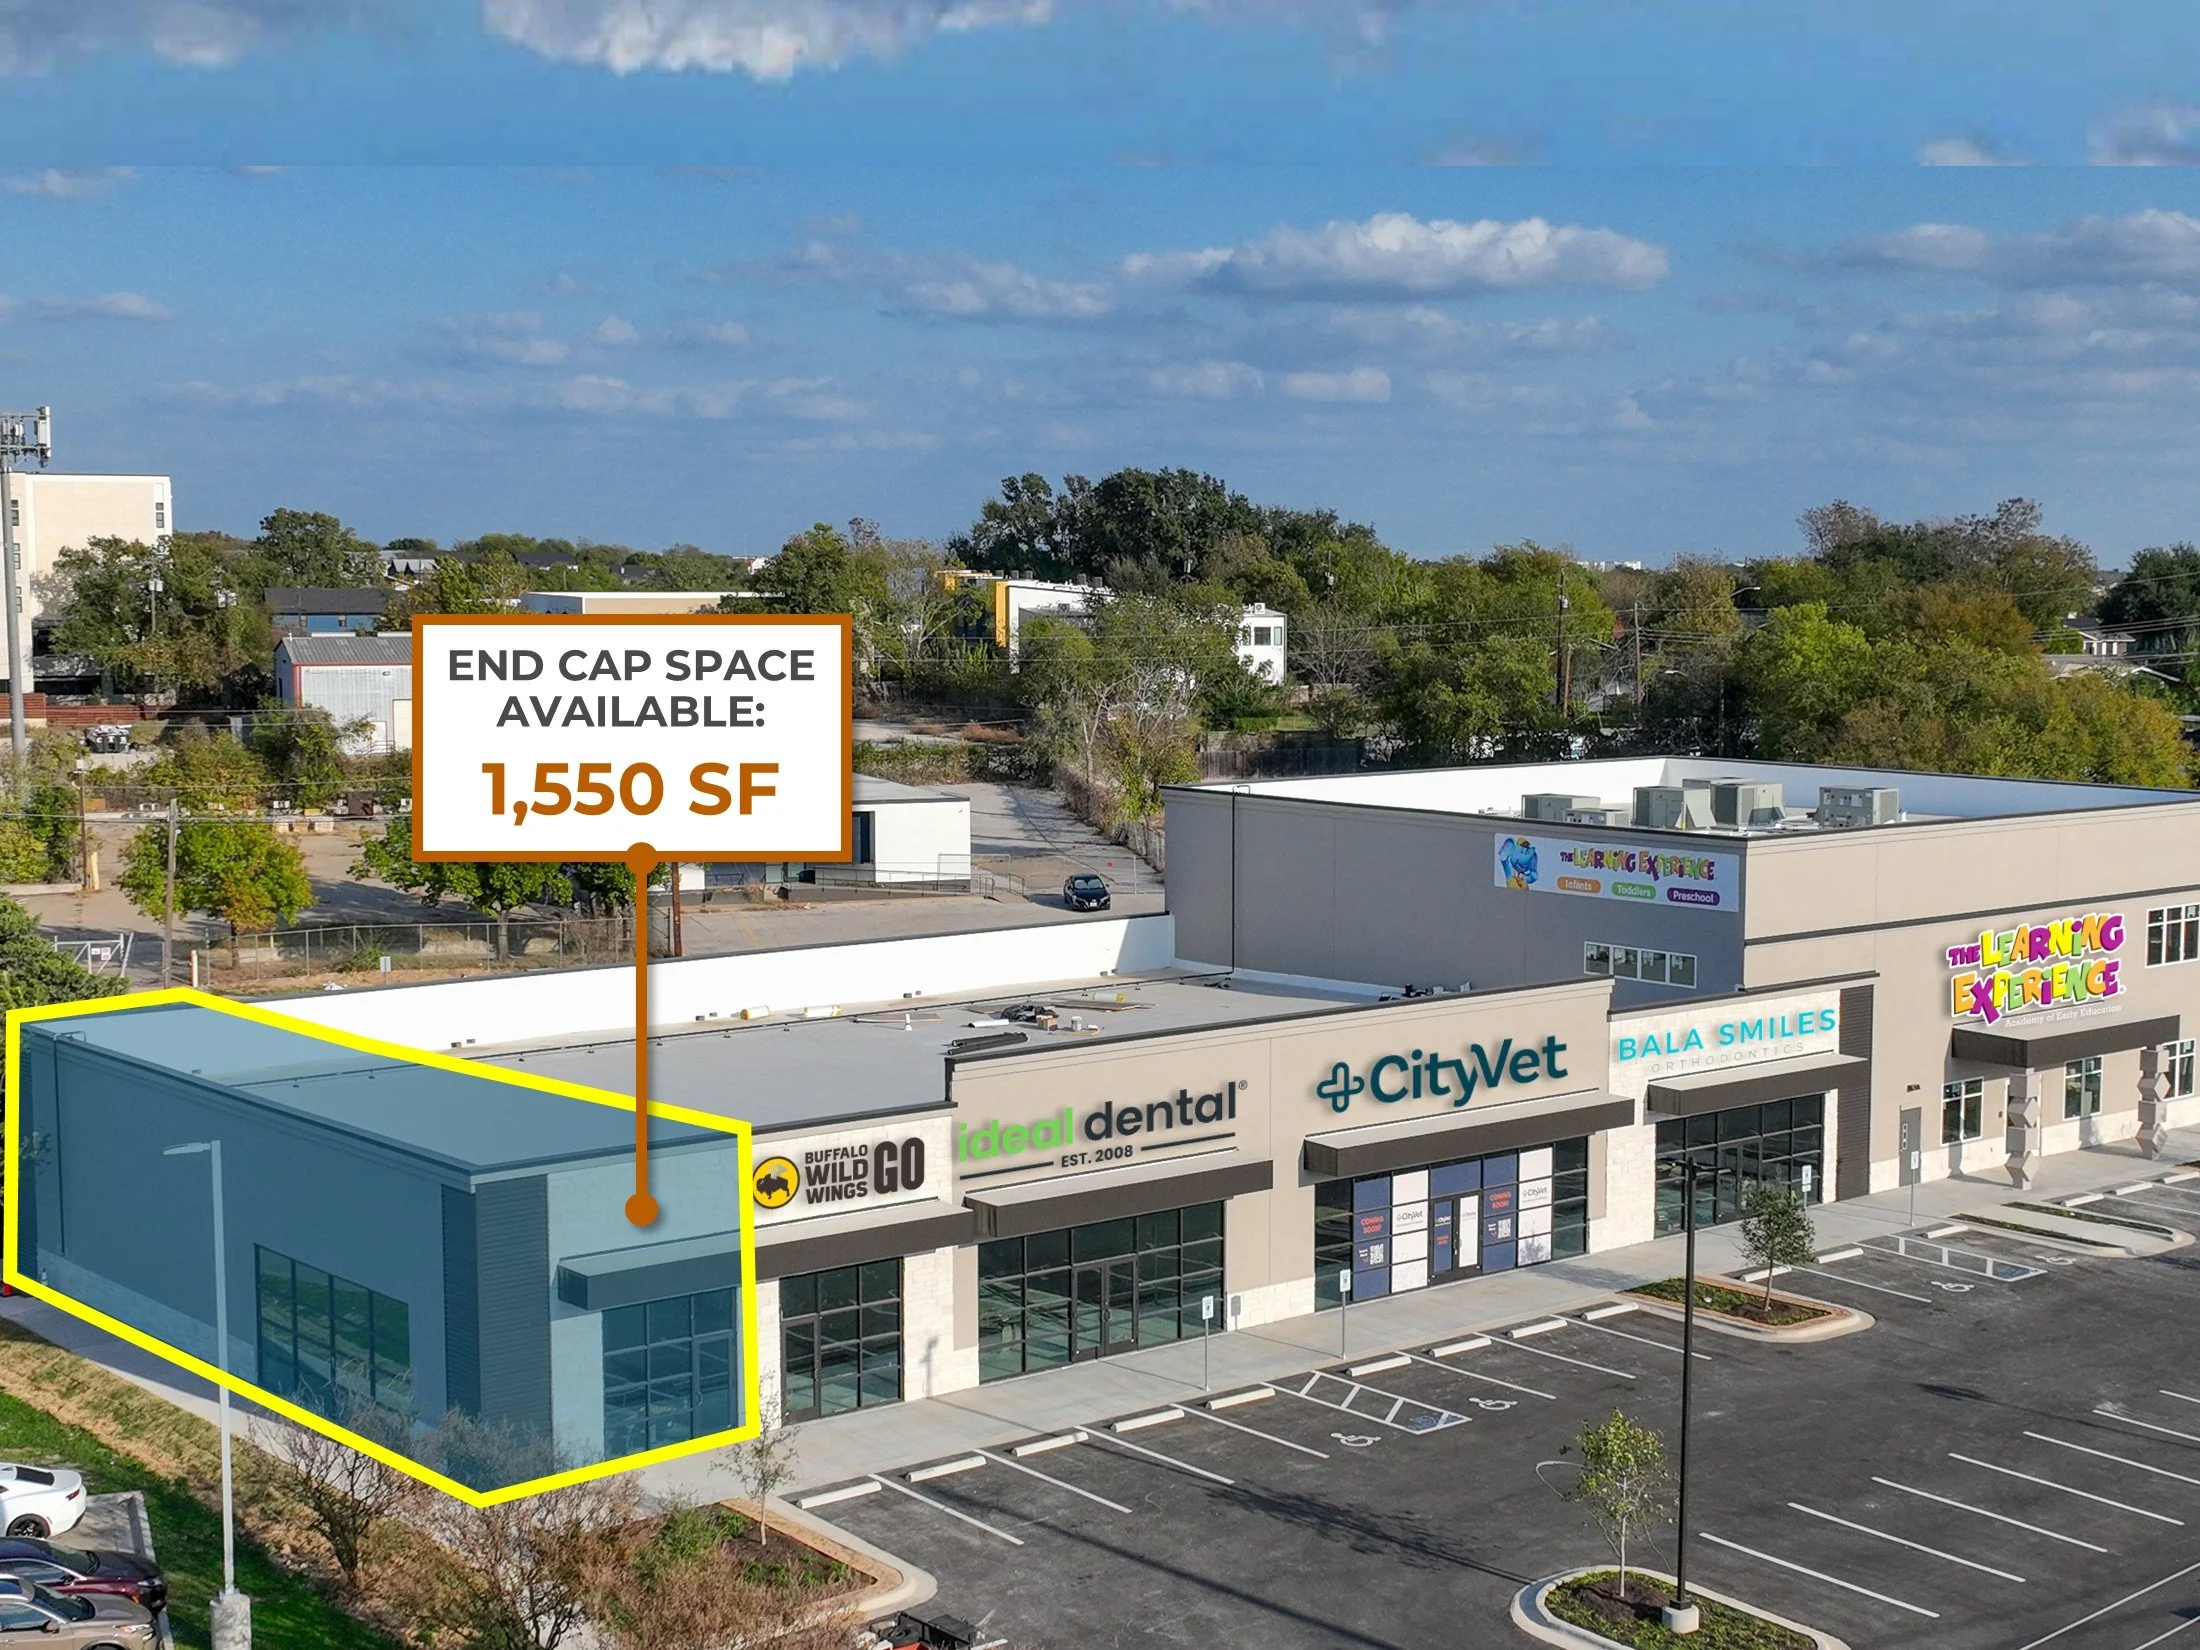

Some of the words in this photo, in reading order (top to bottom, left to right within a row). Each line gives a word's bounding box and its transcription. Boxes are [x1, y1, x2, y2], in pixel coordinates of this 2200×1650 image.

[1565, 879, 1593, 891] Infants
[1617, 884, 1651, 897] Toddlers
[1673, 890, 1714, 904] Preschool
[1948, 944, 1981, 967] THE
[2005, 1015, 2045, 1028] Academy
[2046, 1013, 2055, 1022] of
[2056, 1010, 2078, 1020] Early
[2080, 1004, 2122, 1017] Education
[1619, 1027, 1704, 1062] BALA
[1718, 1008, 1836, 1047] SMILES
[1651, 1042, 1804, 1073] ORTHODONTICS
[1370, 1035, 1568, 1107] CityVet
[958, 1106, 1074, 1162] ideal
[1084, 1081, 1236, 1141] dental
[805, 1144, 868, 1165] BUFFALO
[874, 1137, 925, 1195] GO
[1061, 1151, 1092, 1168] EST.
[1095, 1144, 1133, 1163] 2008
[805, 1158, 869, 1187] WILD
[805, 1181, 868, 1205] WINGS
